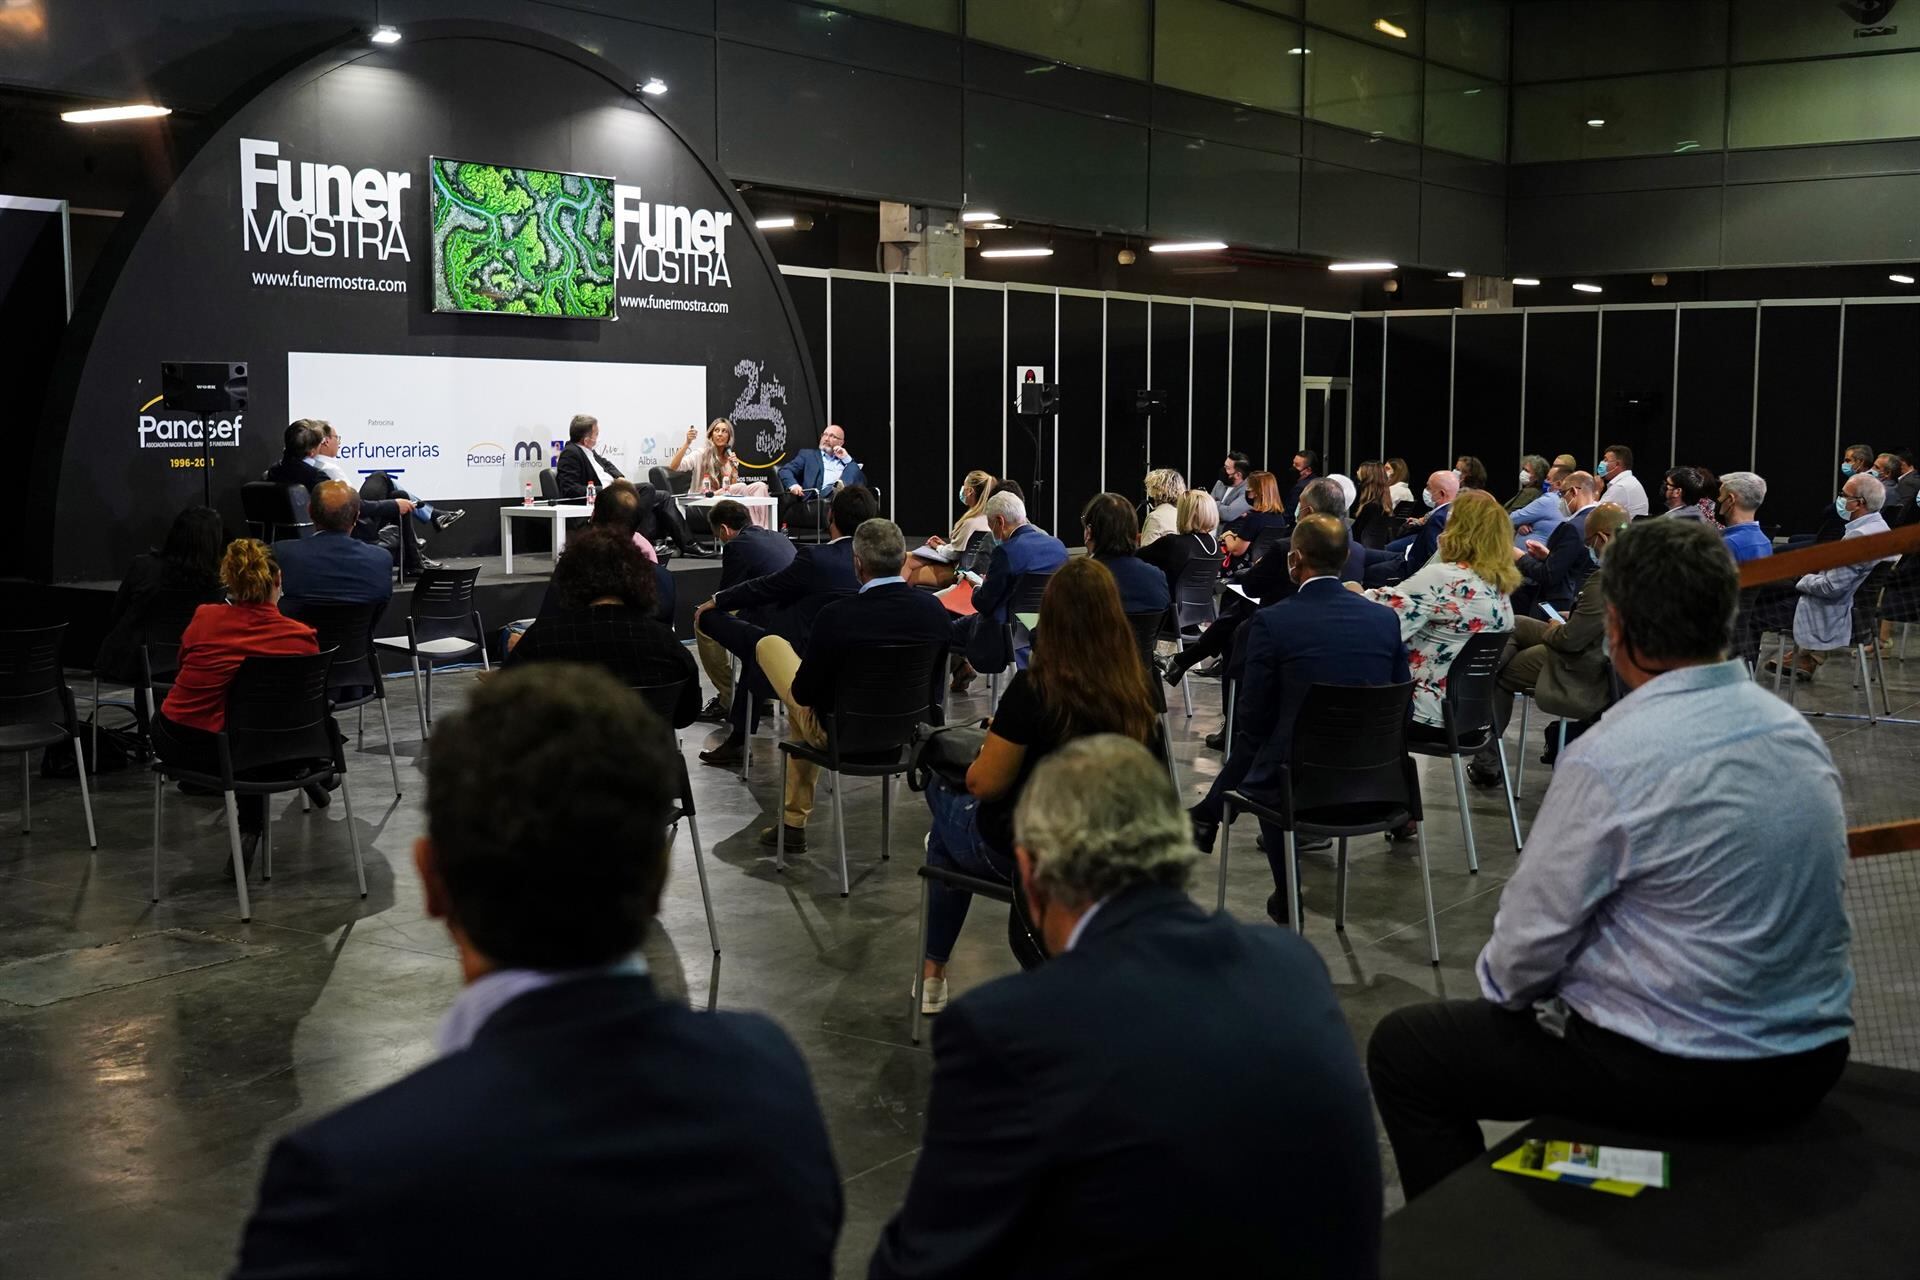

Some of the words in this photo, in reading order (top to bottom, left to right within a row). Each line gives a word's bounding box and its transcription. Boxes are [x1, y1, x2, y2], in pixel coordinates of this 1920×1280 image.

[240, 138, 411, 222] Funer
[614, 184, 732, 254] Funer
[243, 208, 411, 262] MOSTRA
[614, 243, 732, 288] MOSTRA
[252, 270, 407, 293] www.funermostra.com
[620, 294, 729, 314] www.funermostra.com
[138, 415, 243, 448] Panasef
[368, 418, 394, 426] Patrocina
[170, 458, 215, 468] 1996-201
[467, 453, 506, 467] Panasef
[638, 456, 657, 465] Albia
